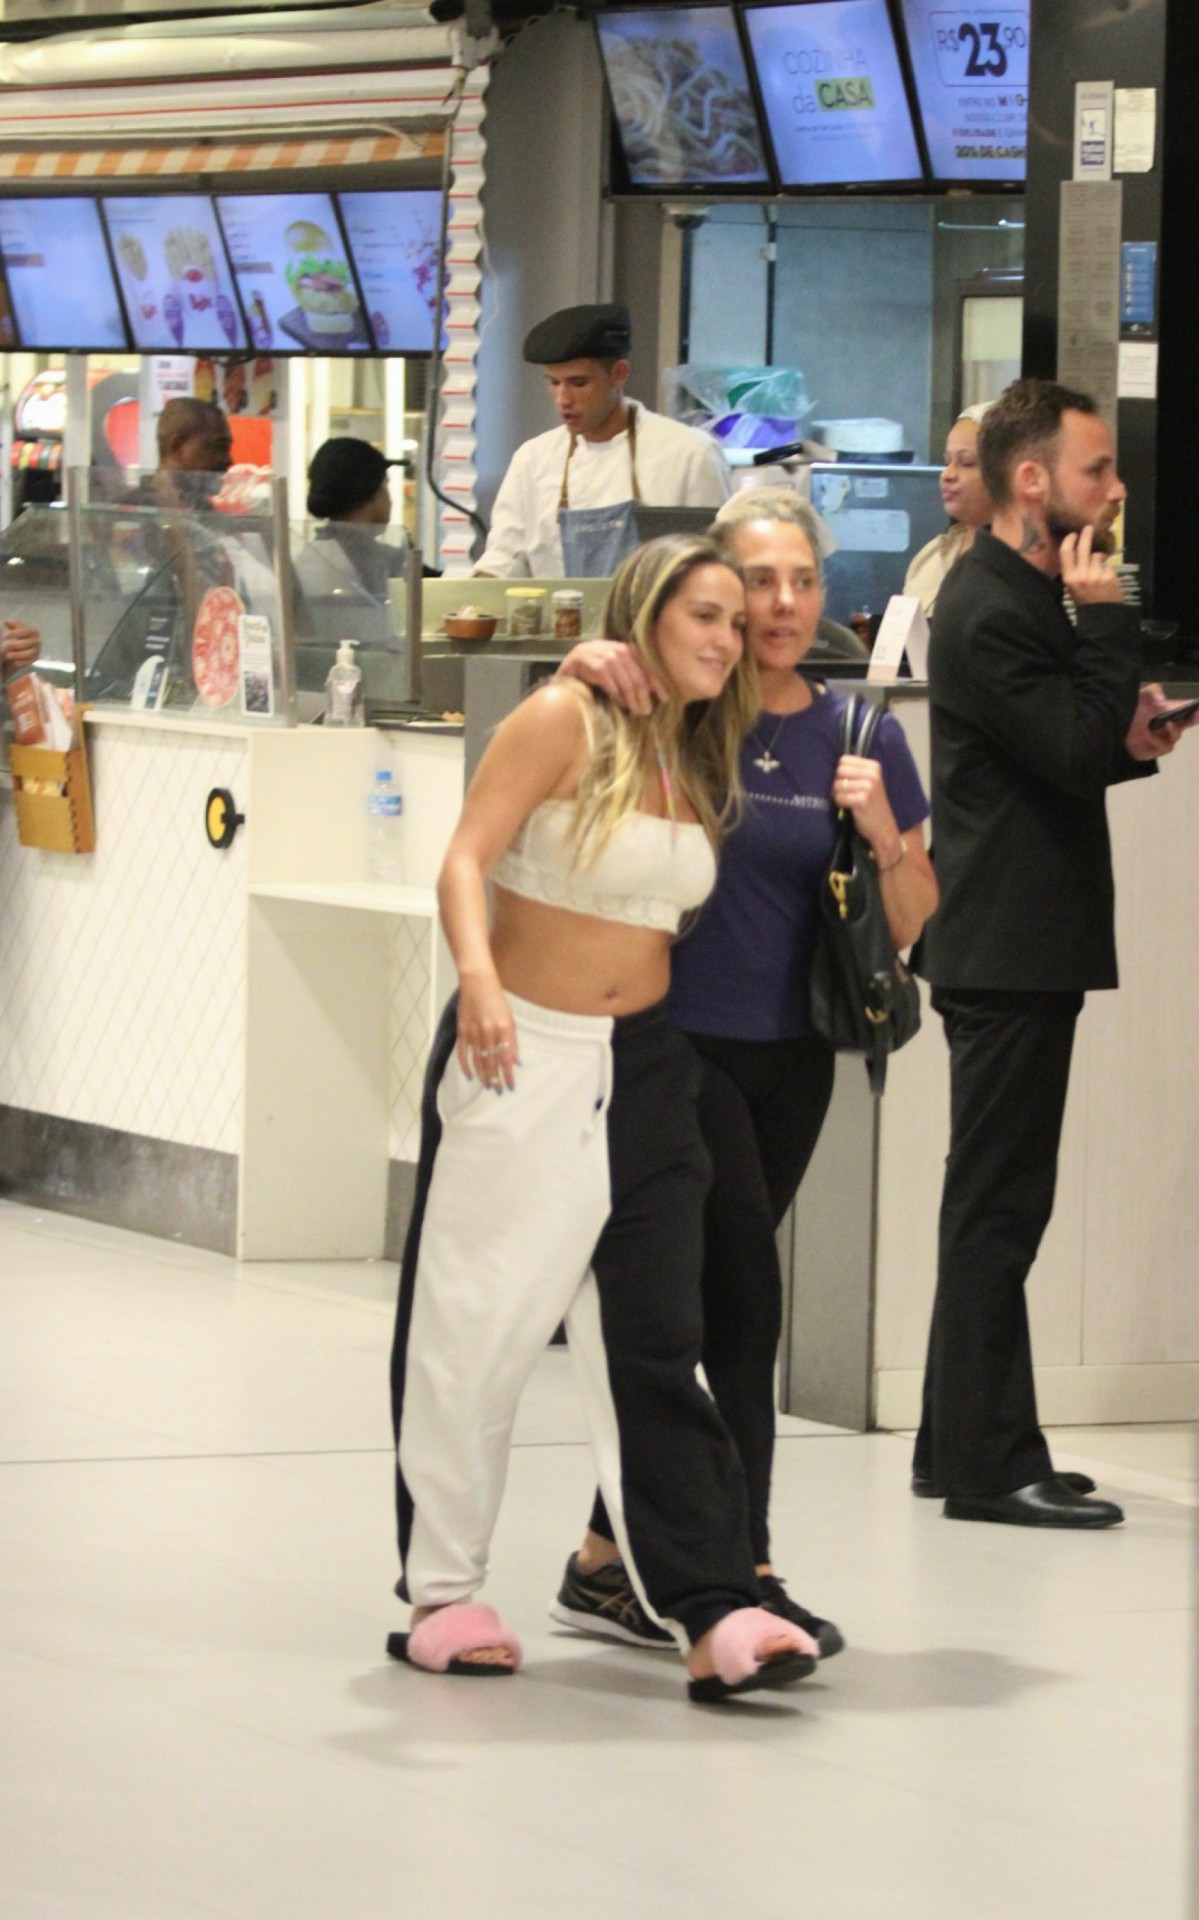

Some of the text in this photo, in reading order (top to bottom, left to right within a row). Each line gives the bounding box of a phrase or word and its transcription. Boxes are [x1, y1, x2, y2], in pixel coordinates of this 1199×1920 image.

[782, 48, 869, 75] COZINHA
[936, 22, 1027, 78] R$ 23 90
[793, 81, 874, 114] da CASA
